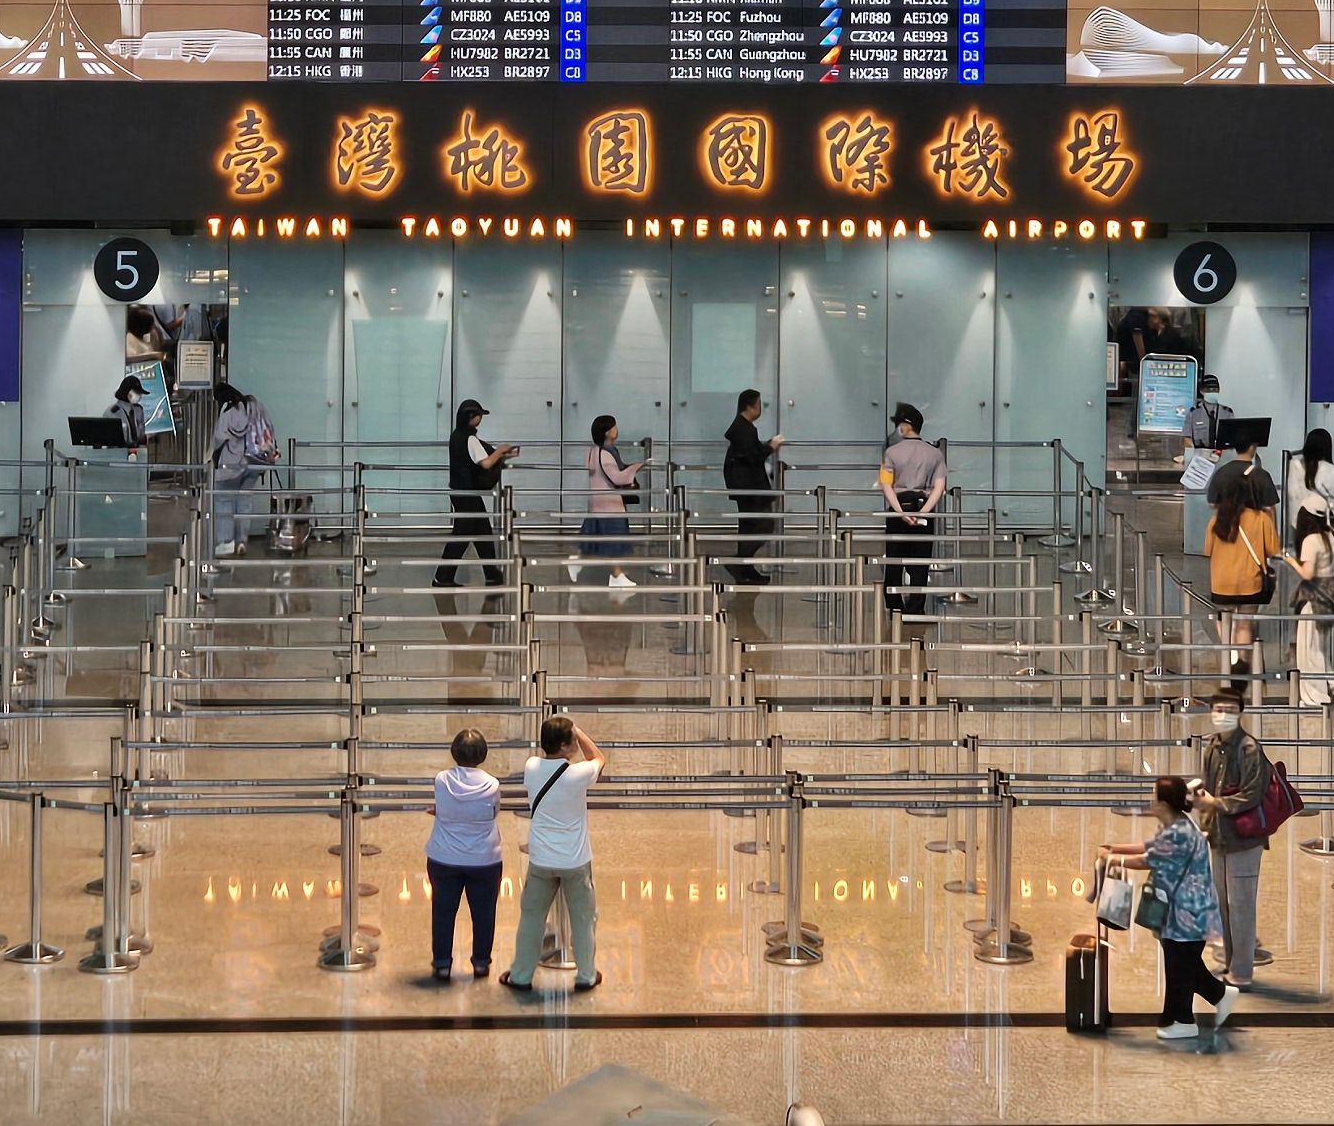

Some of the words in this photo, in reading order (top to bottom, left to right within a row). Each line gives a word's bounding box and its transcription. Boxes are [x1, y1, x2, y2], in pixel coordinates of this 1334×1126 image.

[269, 8, 302, 22] 11:25
[305, 8, 331, 21] FOC
[565, 10, 582, 23] D8
[670, 10, 703, 23] 11:25
[706, 10, 732, 23] FOC
[269, 27, 302, 41] 11:50
[304, 27, 333, 40] CGO
[565, 29, 581, 42] C5
[705, 29, 734, 42] CGO
[269, 46, 302, 59] 11:55
[304, 46, 332, 59] CAN
[268, 64, 302, 78] 12:15
[305, 65, 332, 77] HKG
[220, 107, 1137, 200] 臺灣桃園國際機場
[207, 217, 348, 237] TAIWAN
[402, 217, 572, 237] TAOYUAN
[625, 217, 933, 239] INTERNATIONAL
[982, 218, 1148, 239] AIRPORT
[114, 250, 139, 290] 5
[1193, 254, 1218, 292] 6
